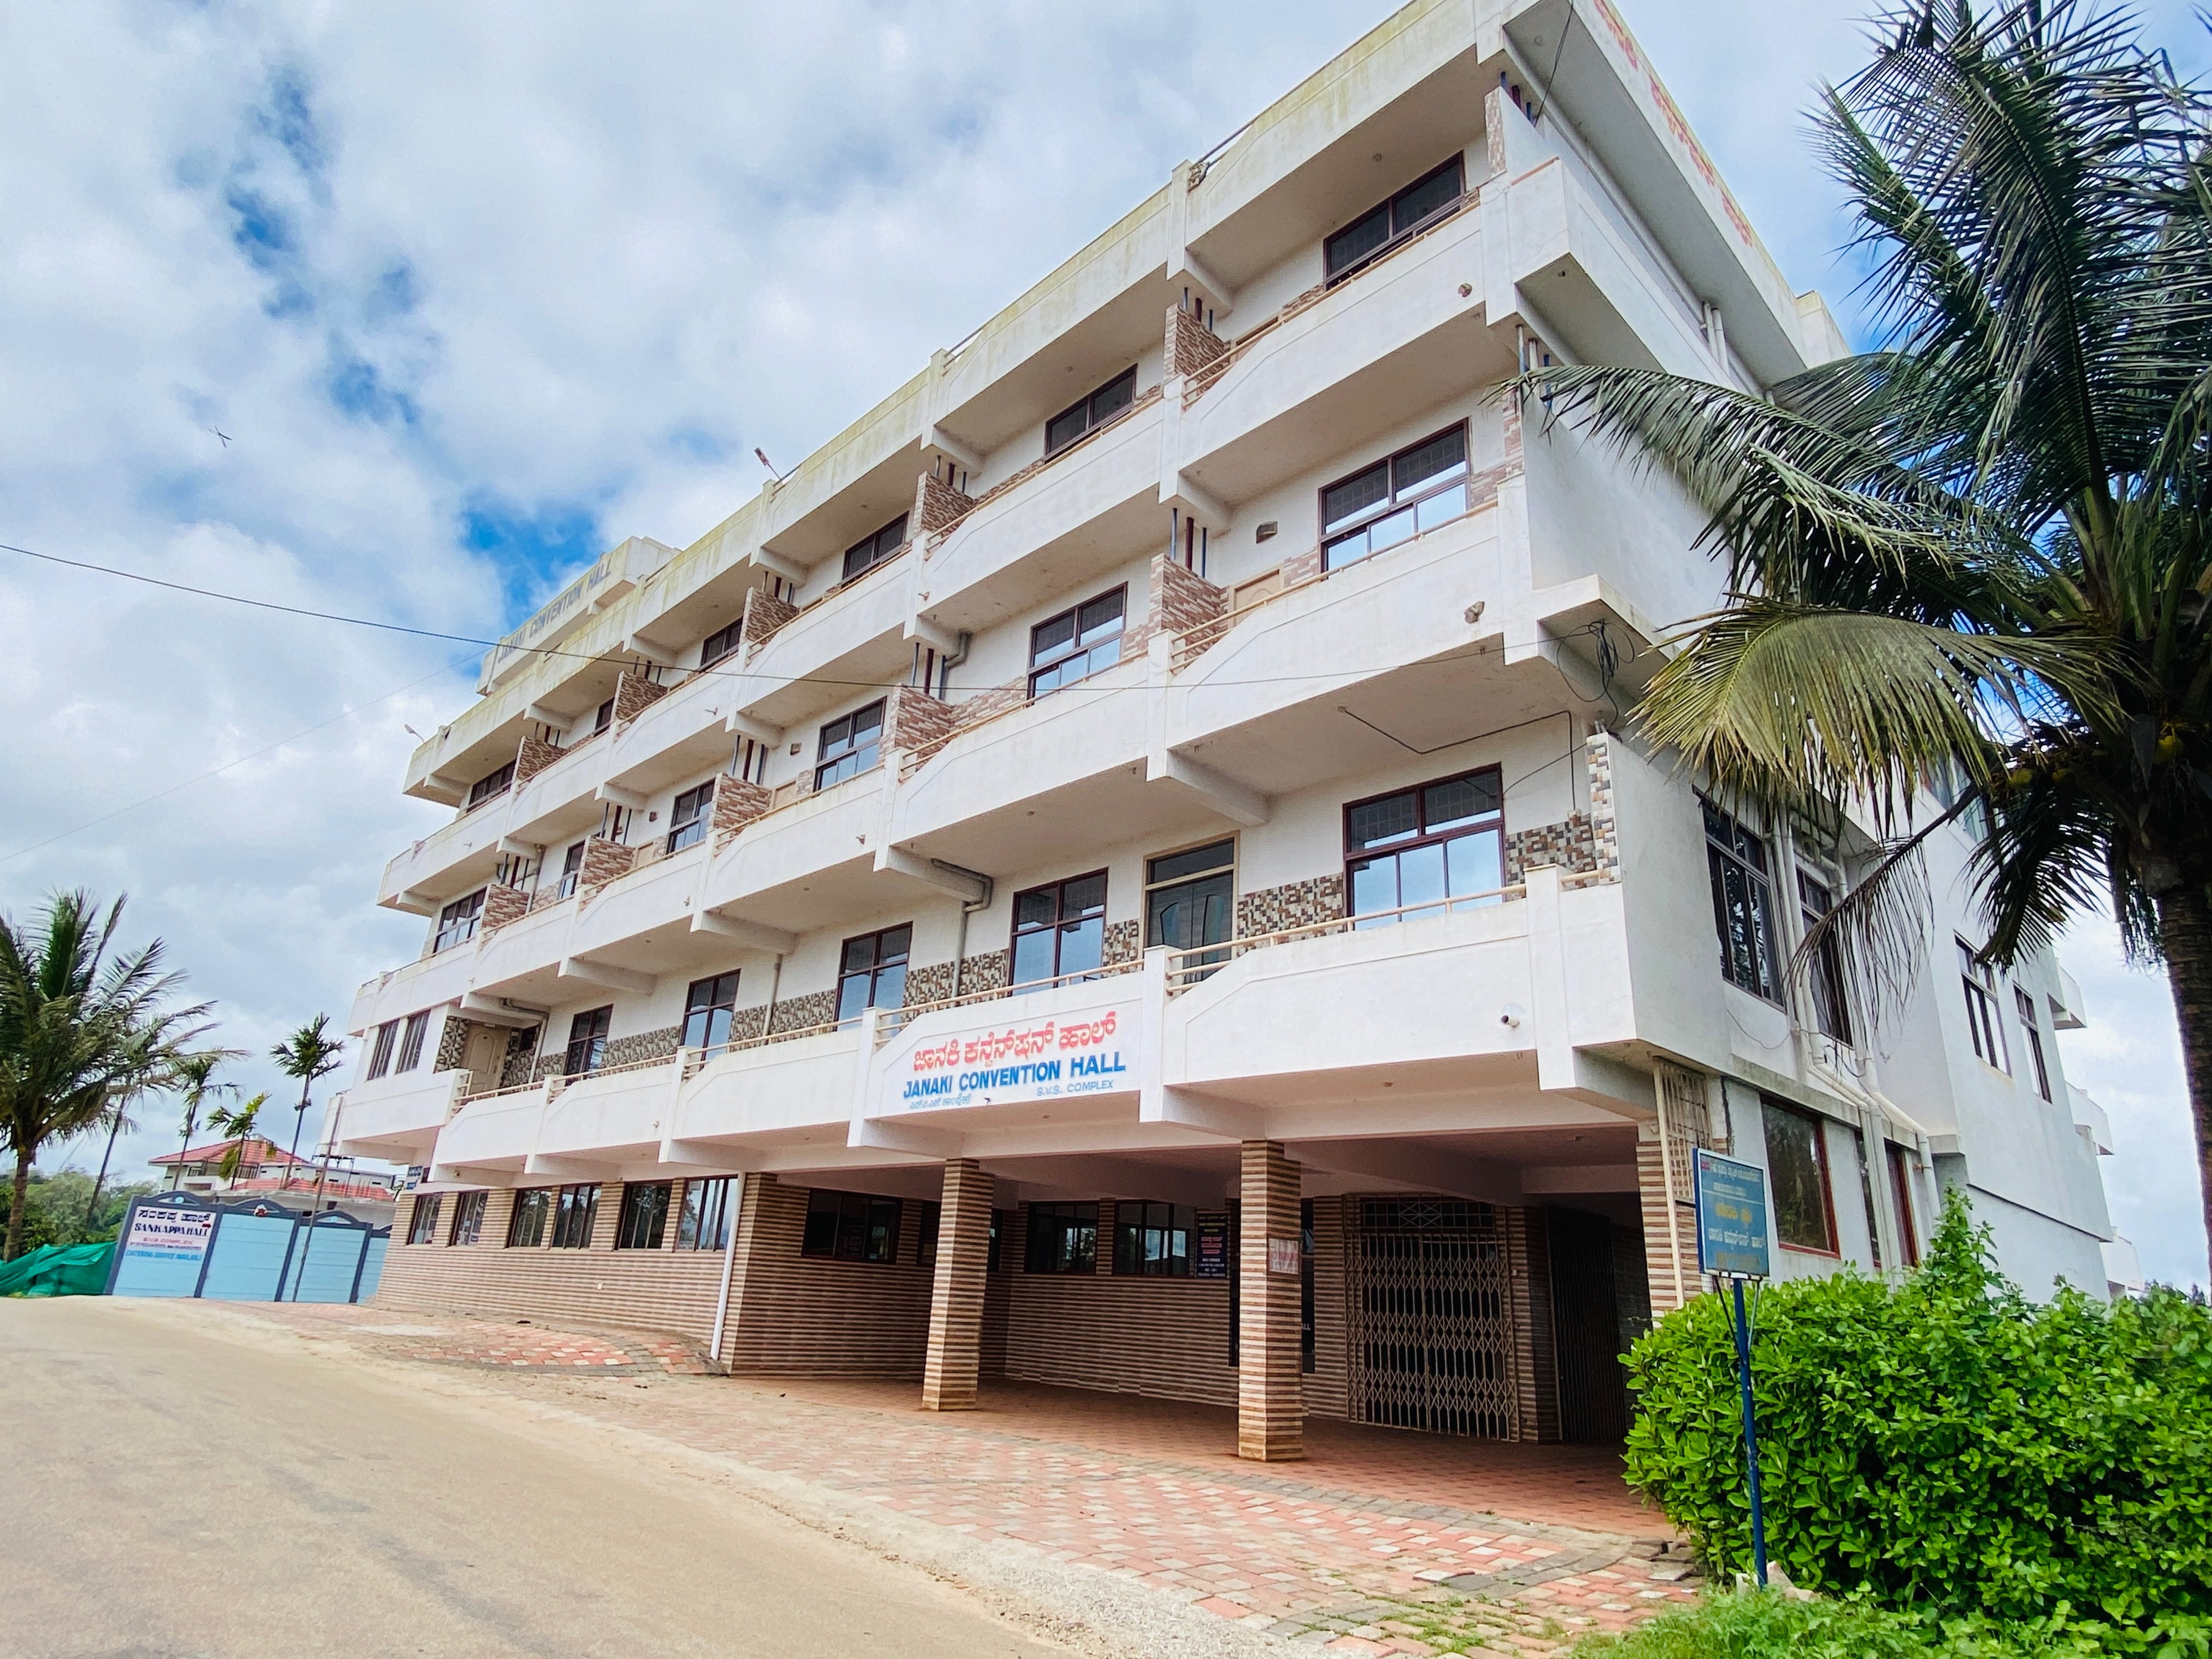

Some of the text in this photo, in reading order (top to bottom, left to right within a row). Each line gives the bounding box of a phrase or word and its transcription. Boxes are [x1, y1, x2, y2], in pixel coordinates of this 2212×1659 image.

[914, 1038, 960, 1072] ಜಾನಕಿ
[1059, 1010, 1117, 1051] ಹಾಲ್
[904, 1052, 1126, 1098] JANAKI CONVENTION HALL
[1067, 1079, 1113, 1092] COMPLEX
